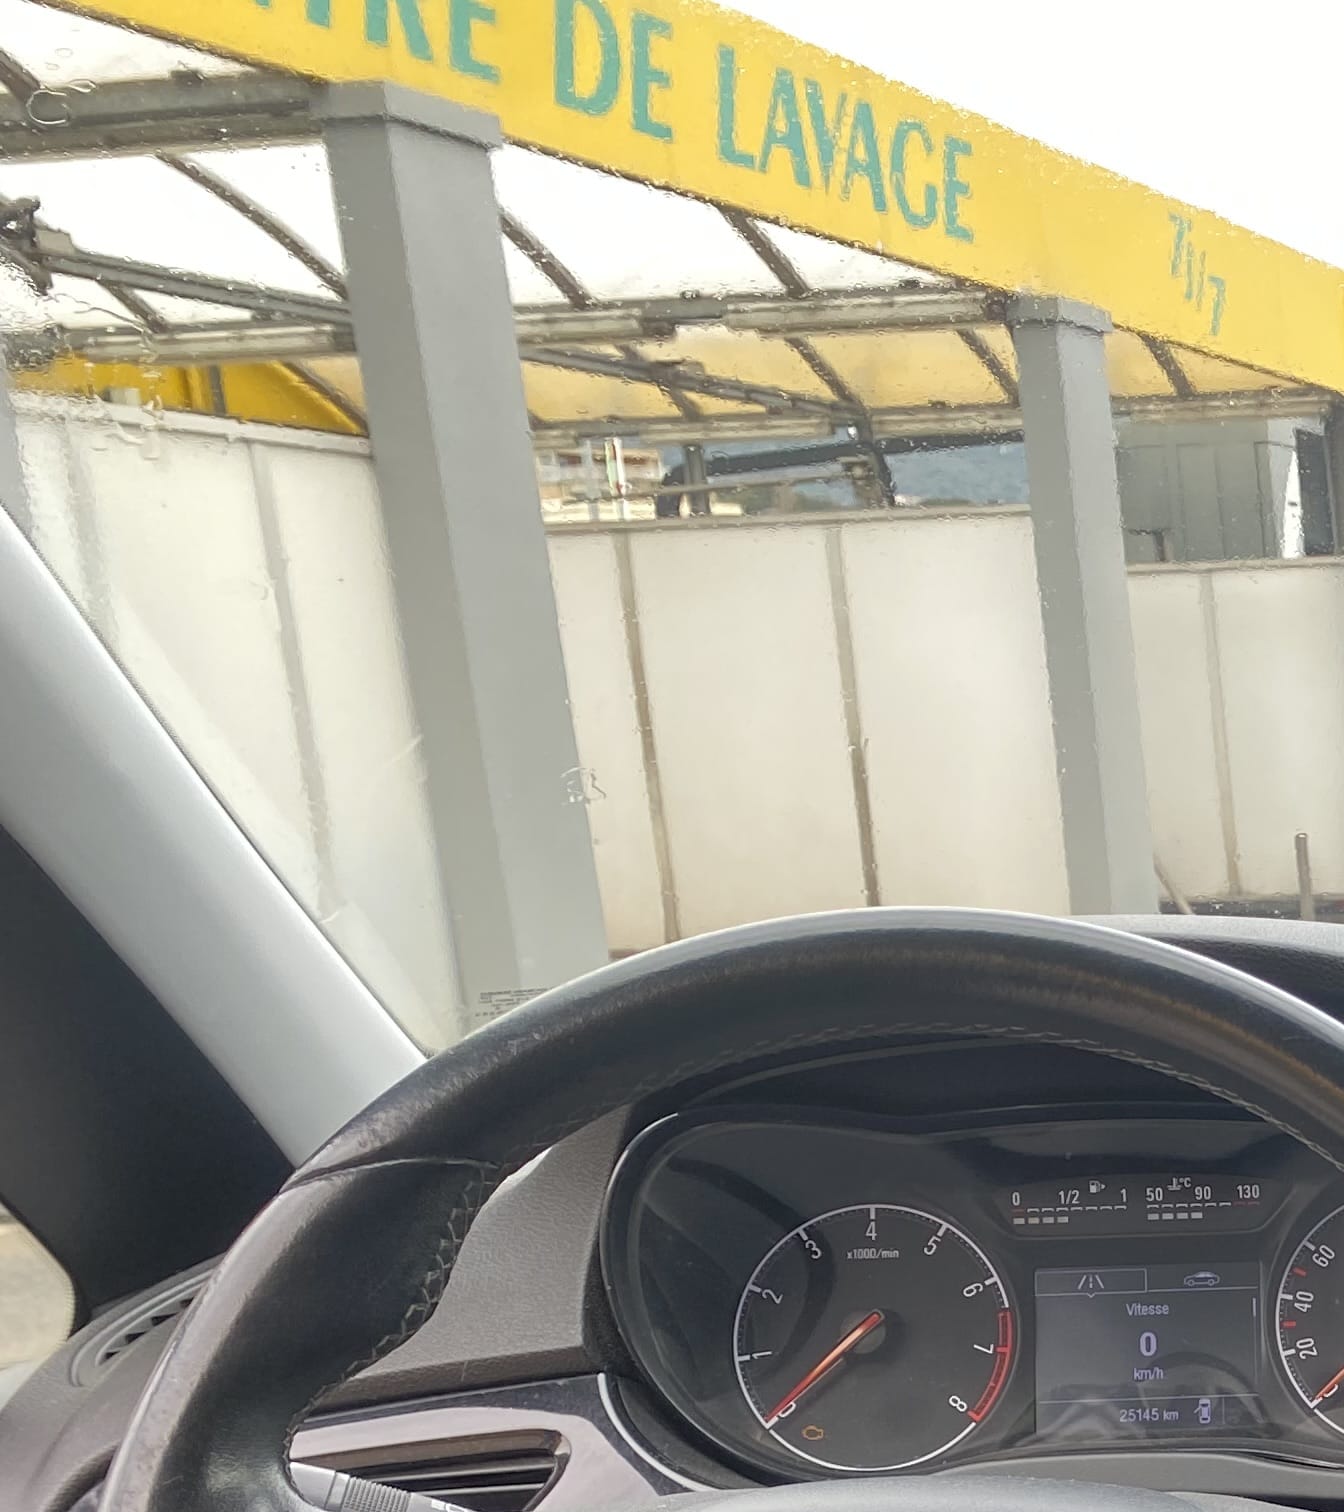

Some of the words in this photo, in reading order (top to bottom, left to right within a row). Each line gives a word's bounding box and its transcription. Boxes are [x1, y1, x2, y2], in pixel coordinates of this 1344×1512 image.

[554, 0, 673, 143] DE
[717, 44, 974, 243] LAVAGE
[1012, 1192, 1021, 1206] 0
[1058, 1190, 1080, 1205] 1/2
[1120, 1189, 1127, 1202] 1
[1146, 1187, 1163, 1201] 50
[1194, 1186, 1212, 1200] 90
[1237, 1184, 1260, 1199] 130
[865, 1221, 878, 1241] 4
[805, 1239, 822, 1259] 3
[923, 1235, 942, 1256] 5
[1311, 1244, 1336, 1268] 60
[761, 1288, 783, 1304] 2
[962, 1283, 983, 1298] 6
[1126, 1303, 1169, 1316] Vitesse
[1294, 1290, 1315, 1313] 40
[973, 1343, 994, 1354] 7
[1139, 1331, 1157, 1356] 0
[1296, 1338, 1318, 1360] 20
[752, 1351, 773, 1360] 1
[1133, 1367, 1164, 1380] km/h
[949, 1395, 968, 1413] 8
[1119, 1408, 1159, 1423] 25145
[1163, 1408, 1179, 1421] km
